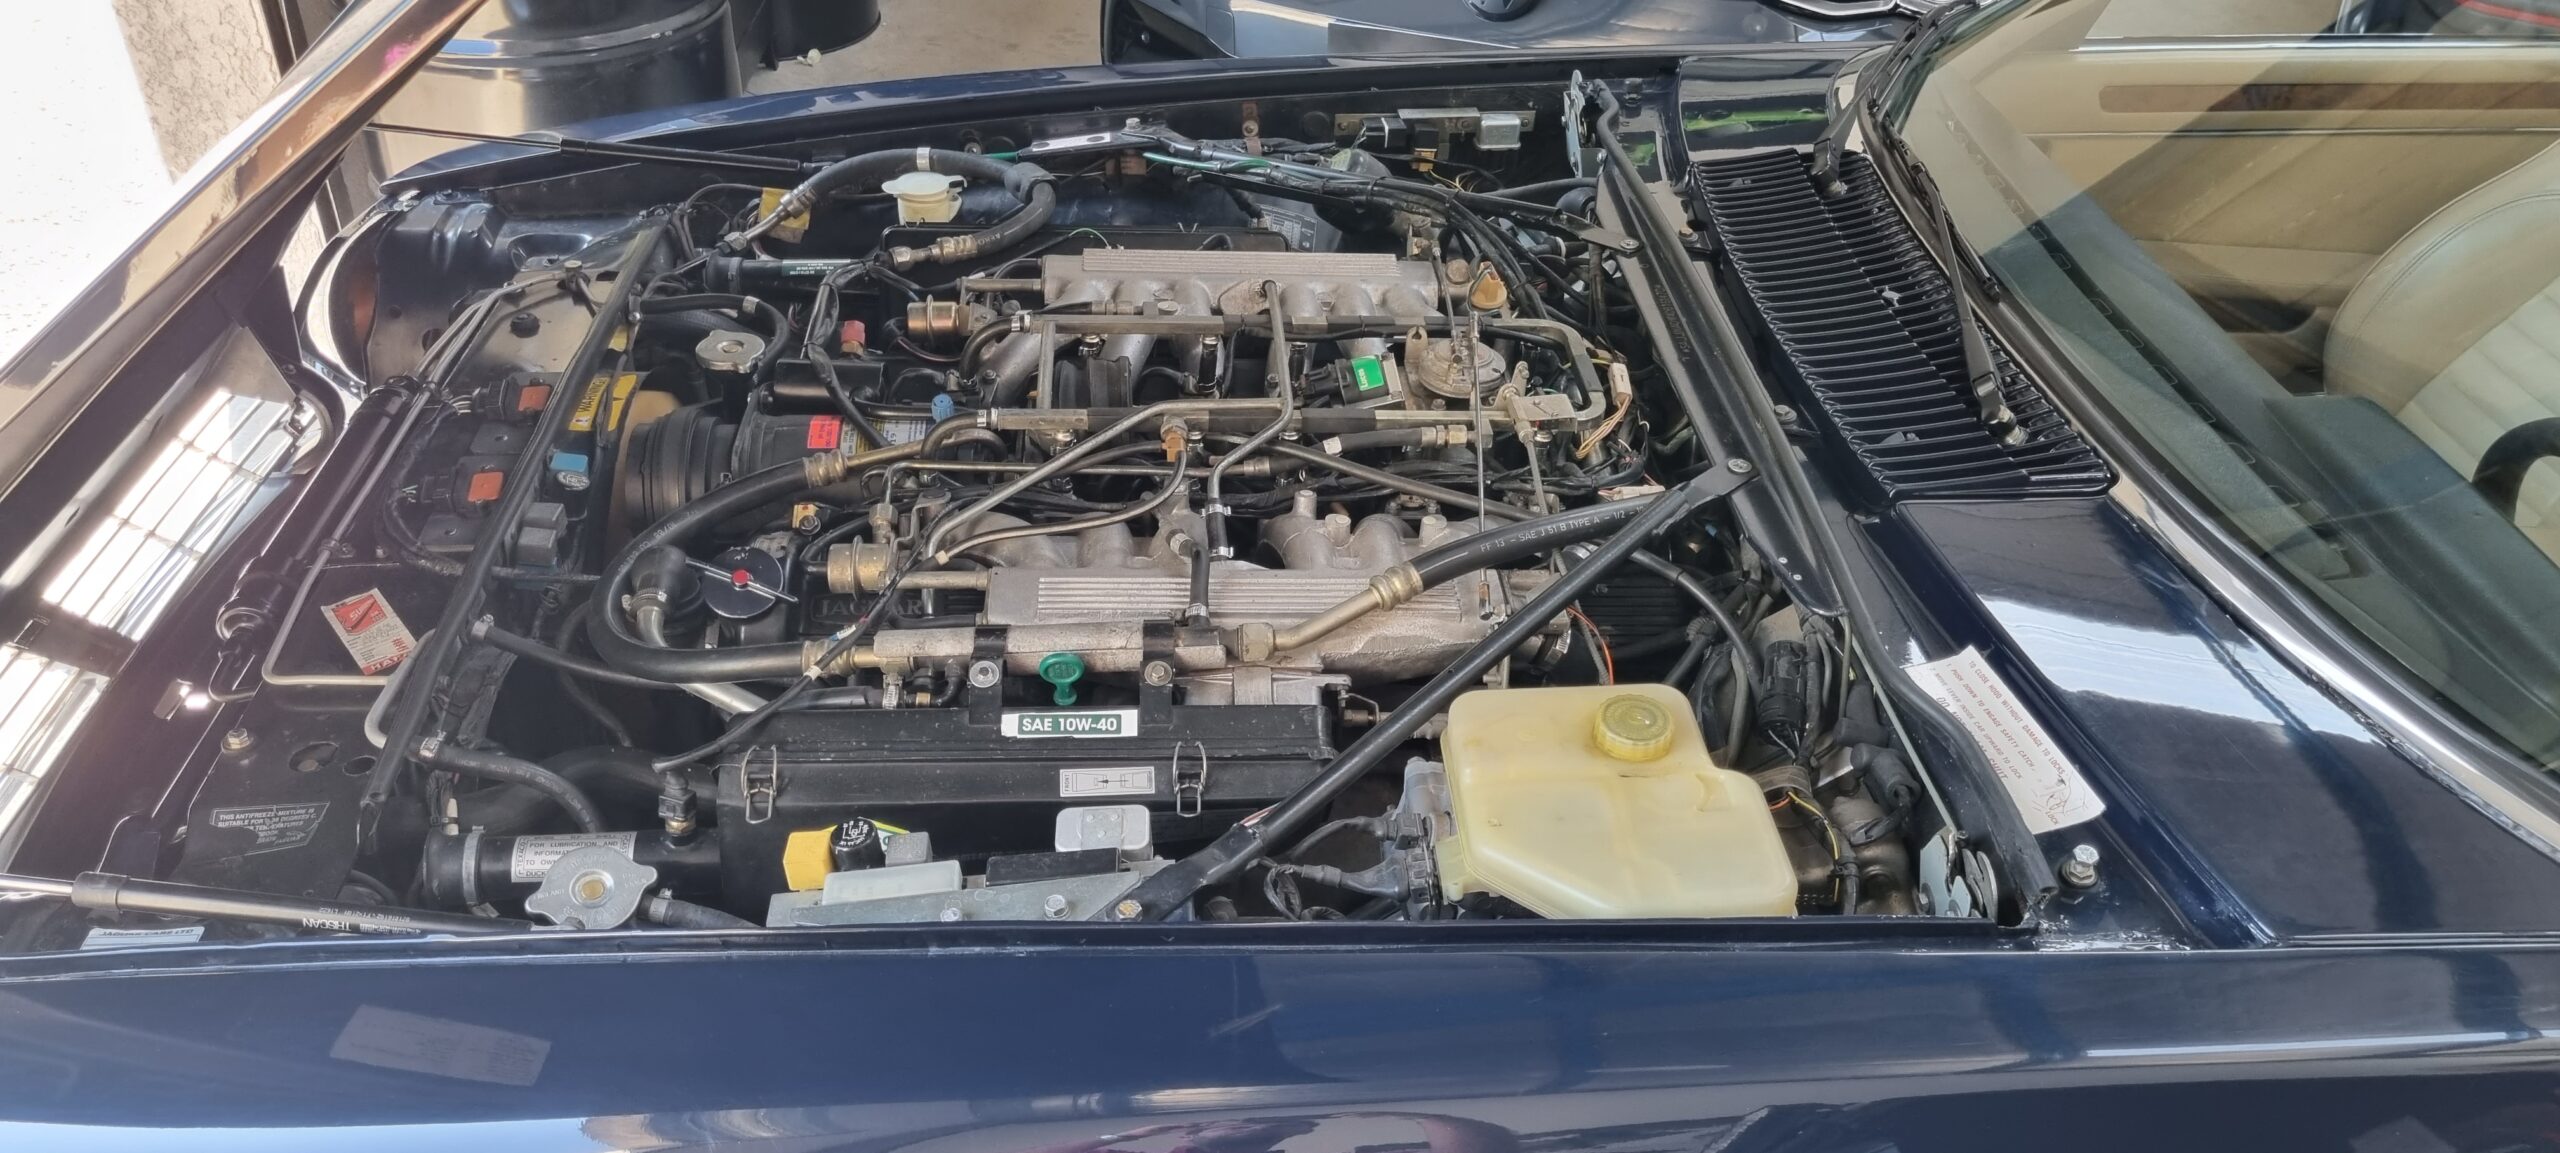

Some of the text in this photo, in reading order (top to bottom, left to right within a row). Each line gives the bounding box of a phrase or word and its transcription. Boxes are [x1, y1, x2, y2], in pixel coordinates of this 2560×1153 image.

[1480, 542, 1491, 552] FF
[1518, 531, 1537, 542] SAE
[1540, 528, 1545, 537] J
[1549, 525, 1557, 534] 51
[1560, 522, 1567, 531] B
[1569, 516, 1591, 529] TYPE
[1593, 516, 1600, 524] A
[1613, 510, 1625, 520] 1/2
[1022, 717, 1117, 731] SAE 10W-40
[2001, 700, 2023, 724] WITHOUT
[2022, 724, 2043, 748] DAMAGE
[220, 813, 234, 821] THIS
